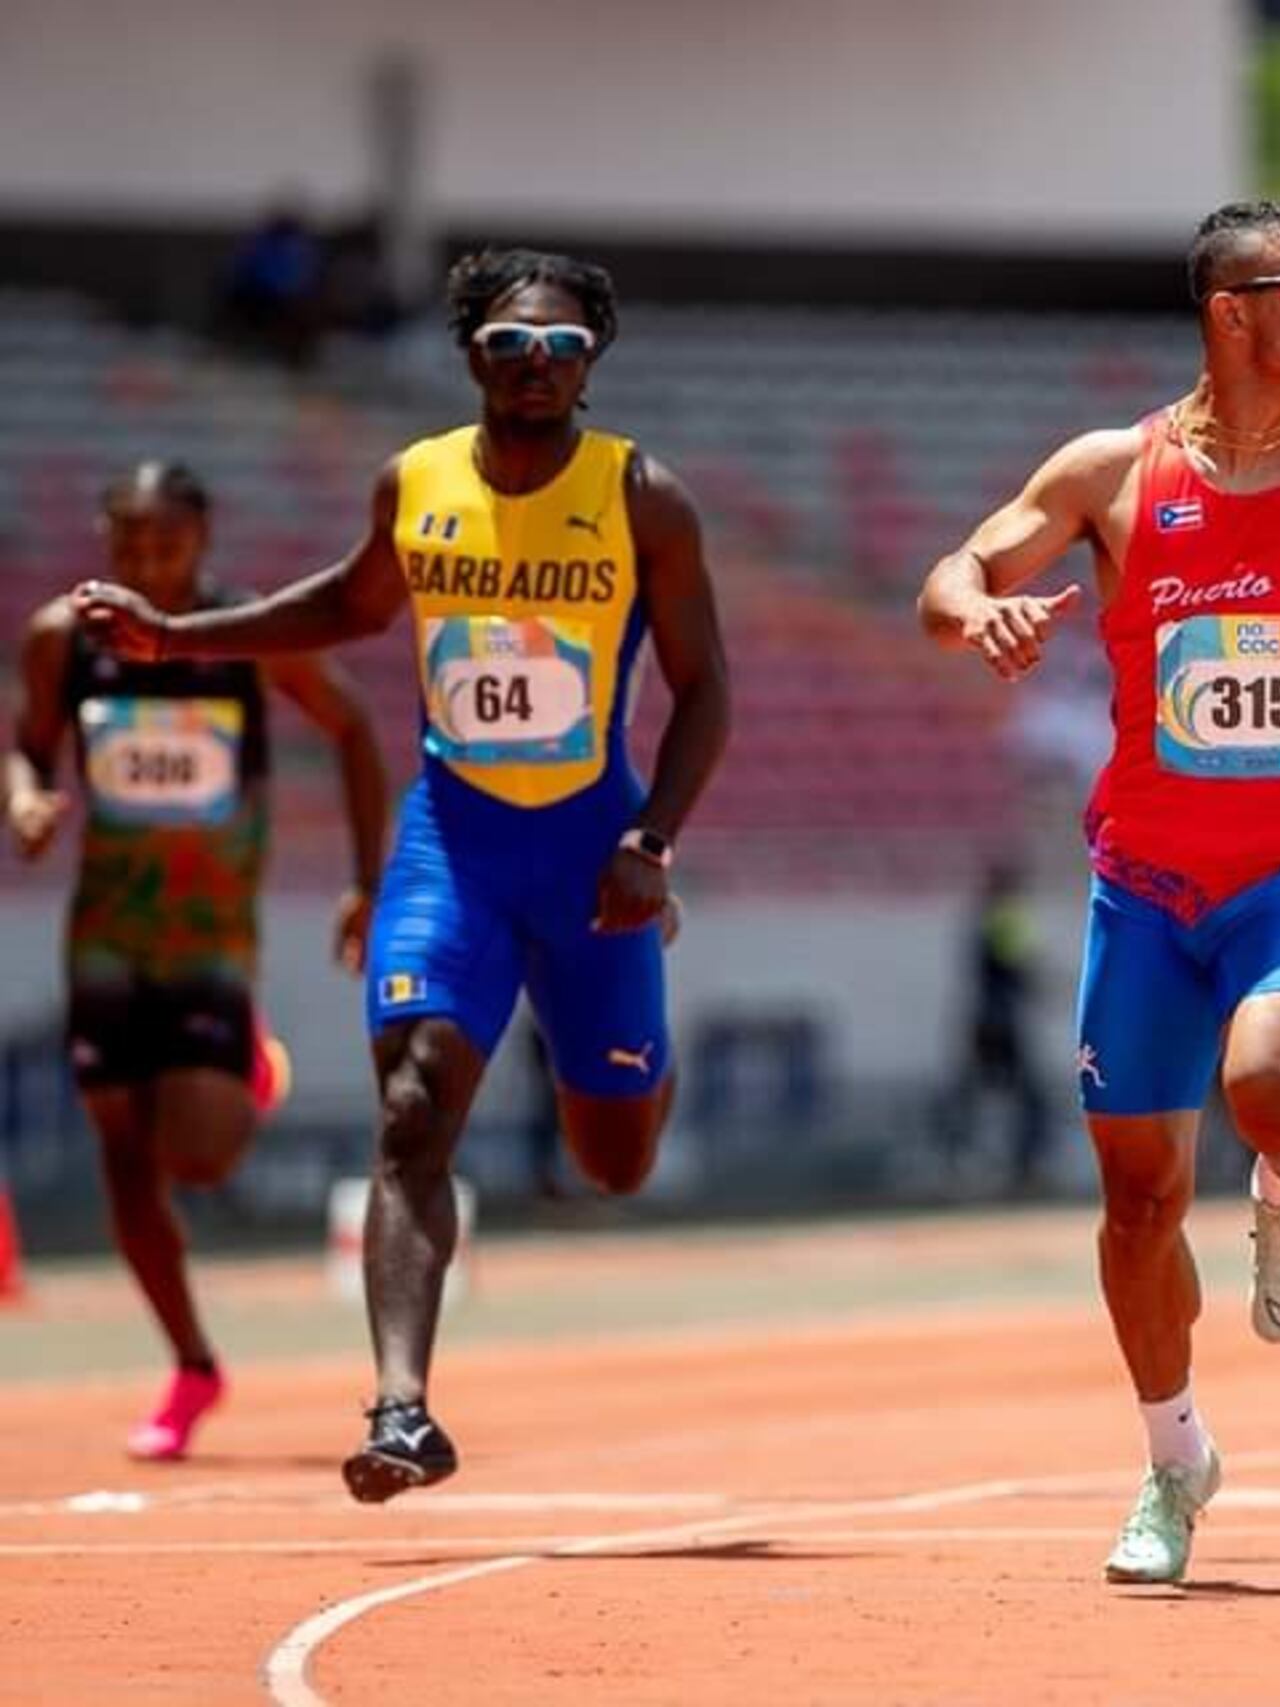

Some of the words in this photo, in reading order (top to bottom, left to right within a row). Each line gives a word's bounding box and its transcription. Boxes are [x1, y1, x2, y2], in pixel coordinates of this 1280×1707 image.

[407, 551, 616, 604] BARBADOS
[1149, 574, 1272, 615] Puerto
[475, 674, 534, 723] 64
